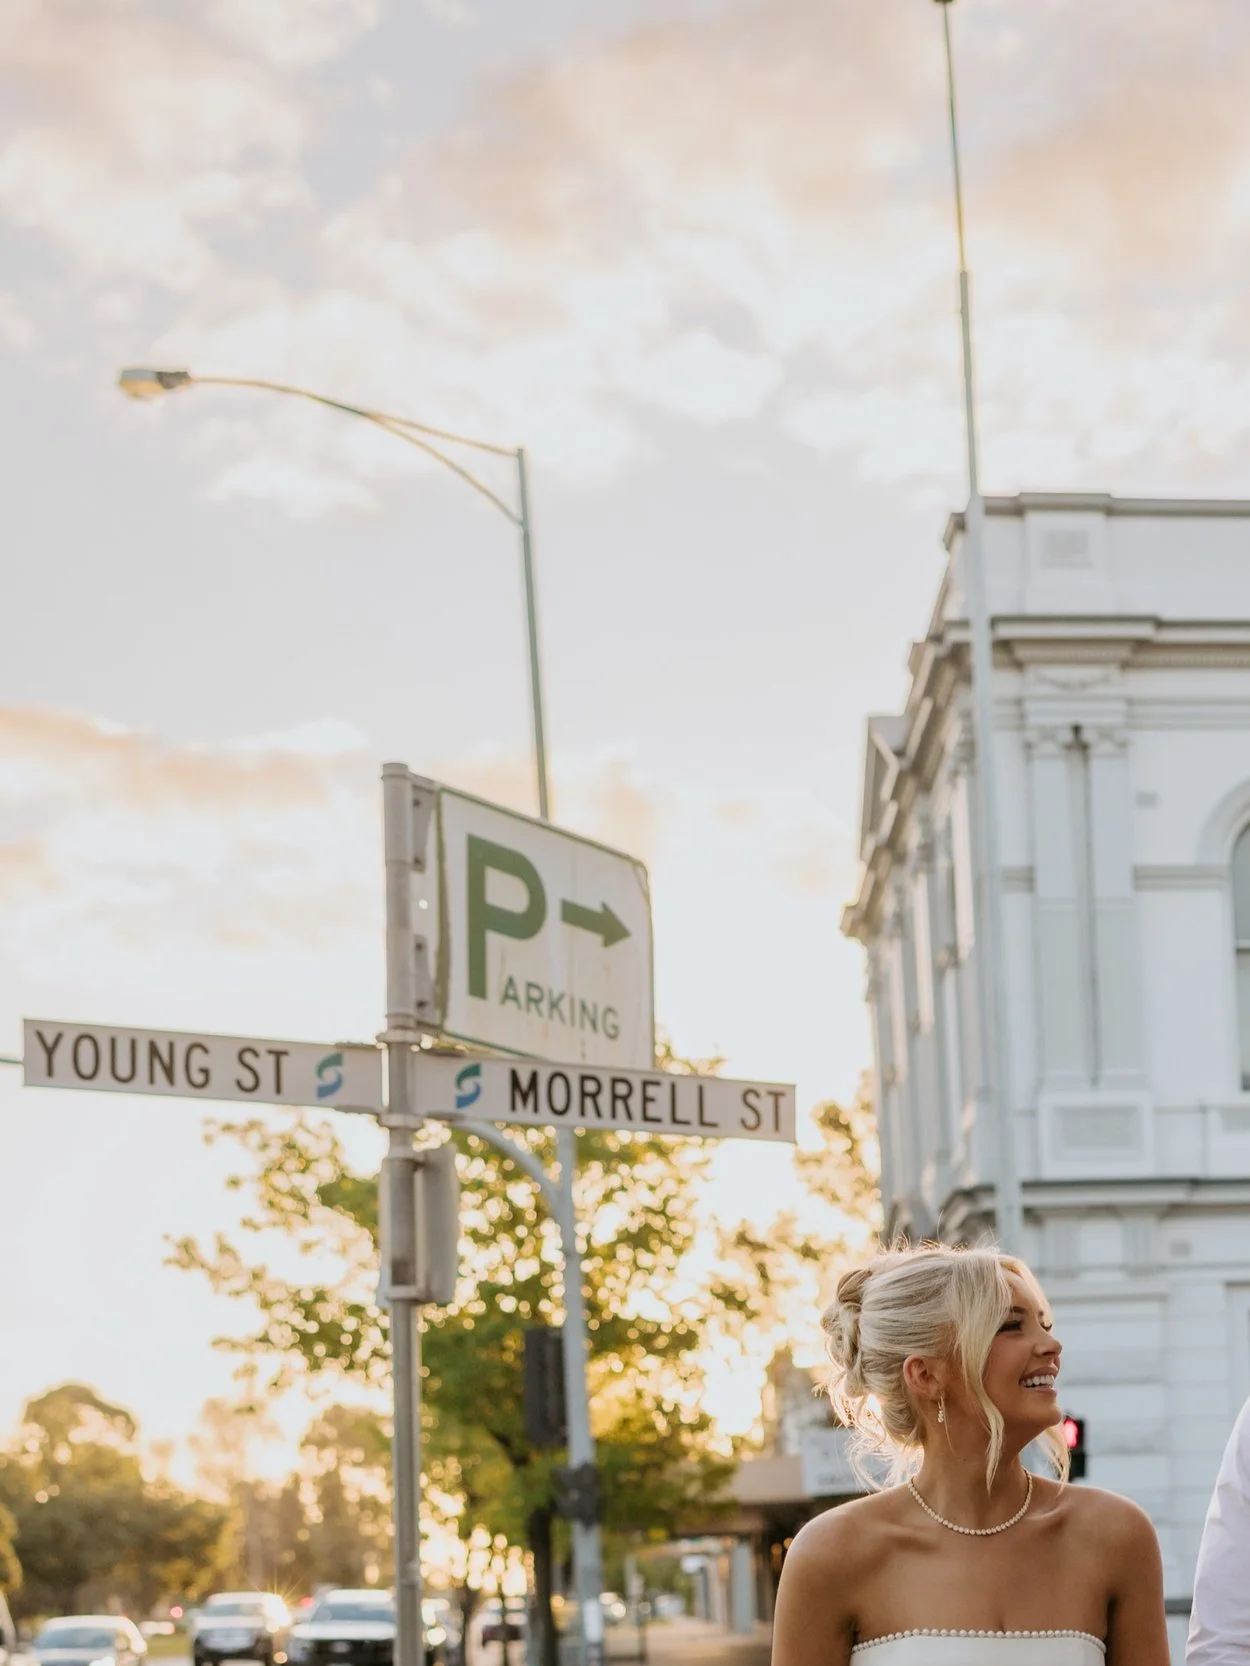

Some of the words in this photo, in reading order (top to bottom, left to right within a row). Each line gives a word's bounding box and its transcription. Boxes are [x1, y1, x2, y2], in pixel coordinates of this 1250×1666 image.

[35, 1029, 211, 1090] YOUNG
[235, 1046, 290, 1096] ST
[508, 1067, 720, 1128] MORRELL
[739, 1087, 786, 1133] ST
